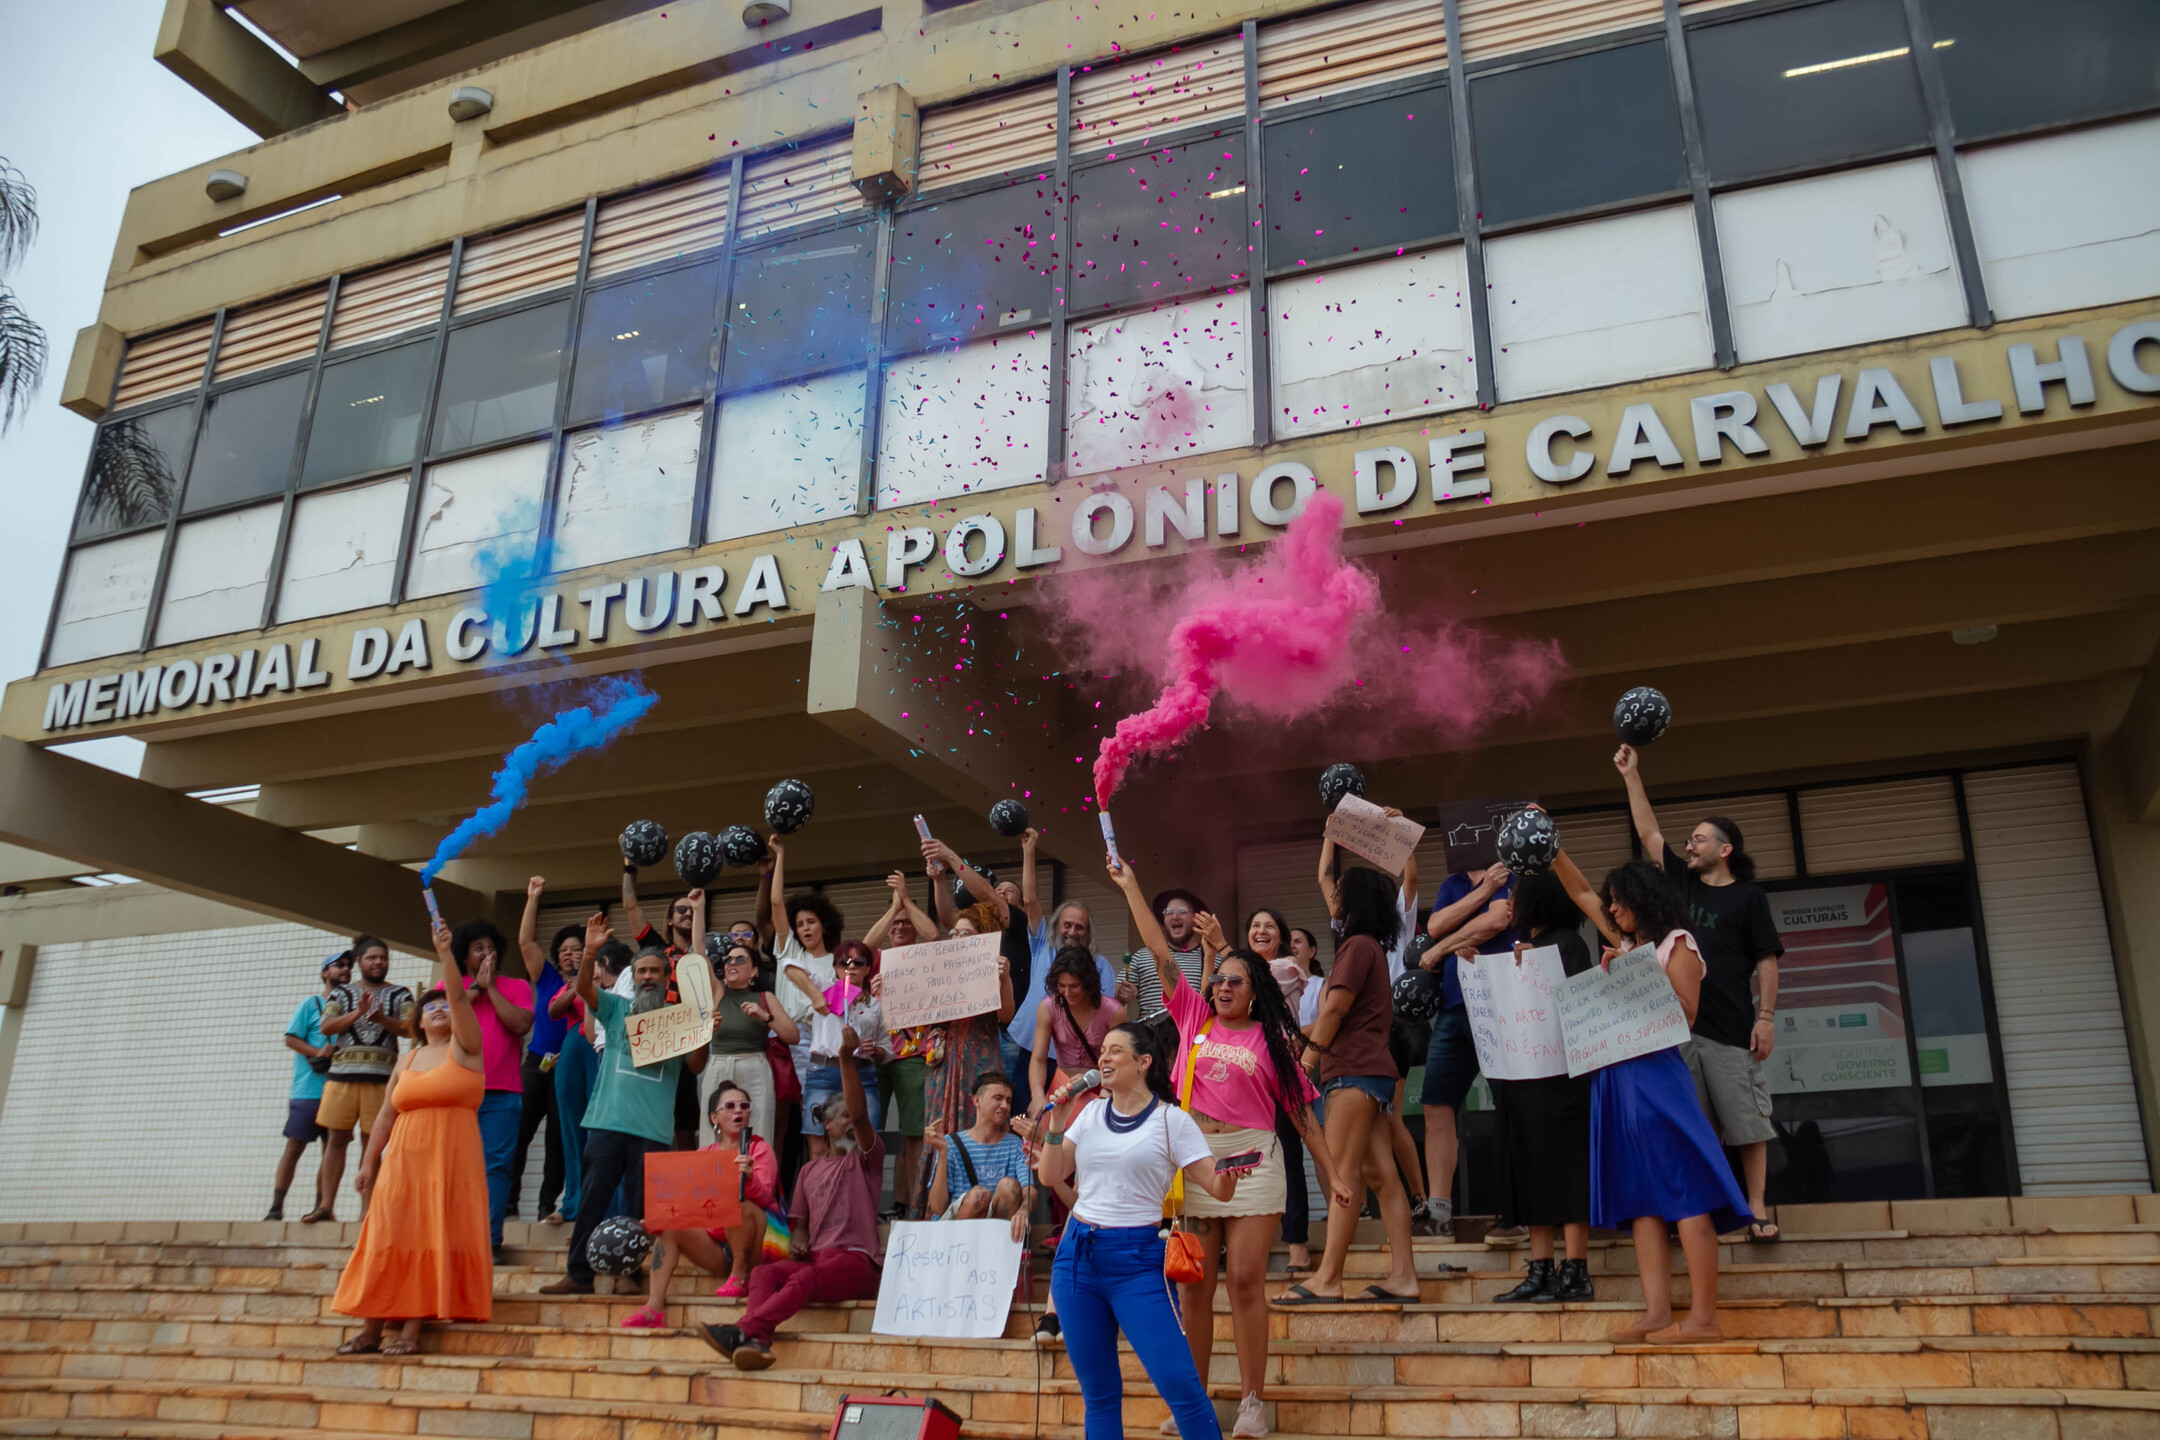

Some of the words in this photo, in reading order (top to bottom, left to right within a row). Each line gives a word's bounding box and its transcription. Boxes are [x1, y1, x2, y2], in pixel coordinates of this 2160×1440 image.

[42, 638, 331, 731] MEMORIAL
[347, 617, 431, 681] DA
[445, 553, 790, 664] CULTURA
[1353, 430, 1491, 516] DE
[1524, 320, 2160, 486] CARVALHO
[1782, 907, 1811, 916] NOSSOS
[1783, 911, 1849, 926] CULTURAIS
[884, 986, 897, 997] DA
[1515, 1008, 1547, 1024] ARTE
[1836, 1058, 1896, 1071] GOVERNO
[1821, 1068, 1898, 1083] CONSCIENTE
